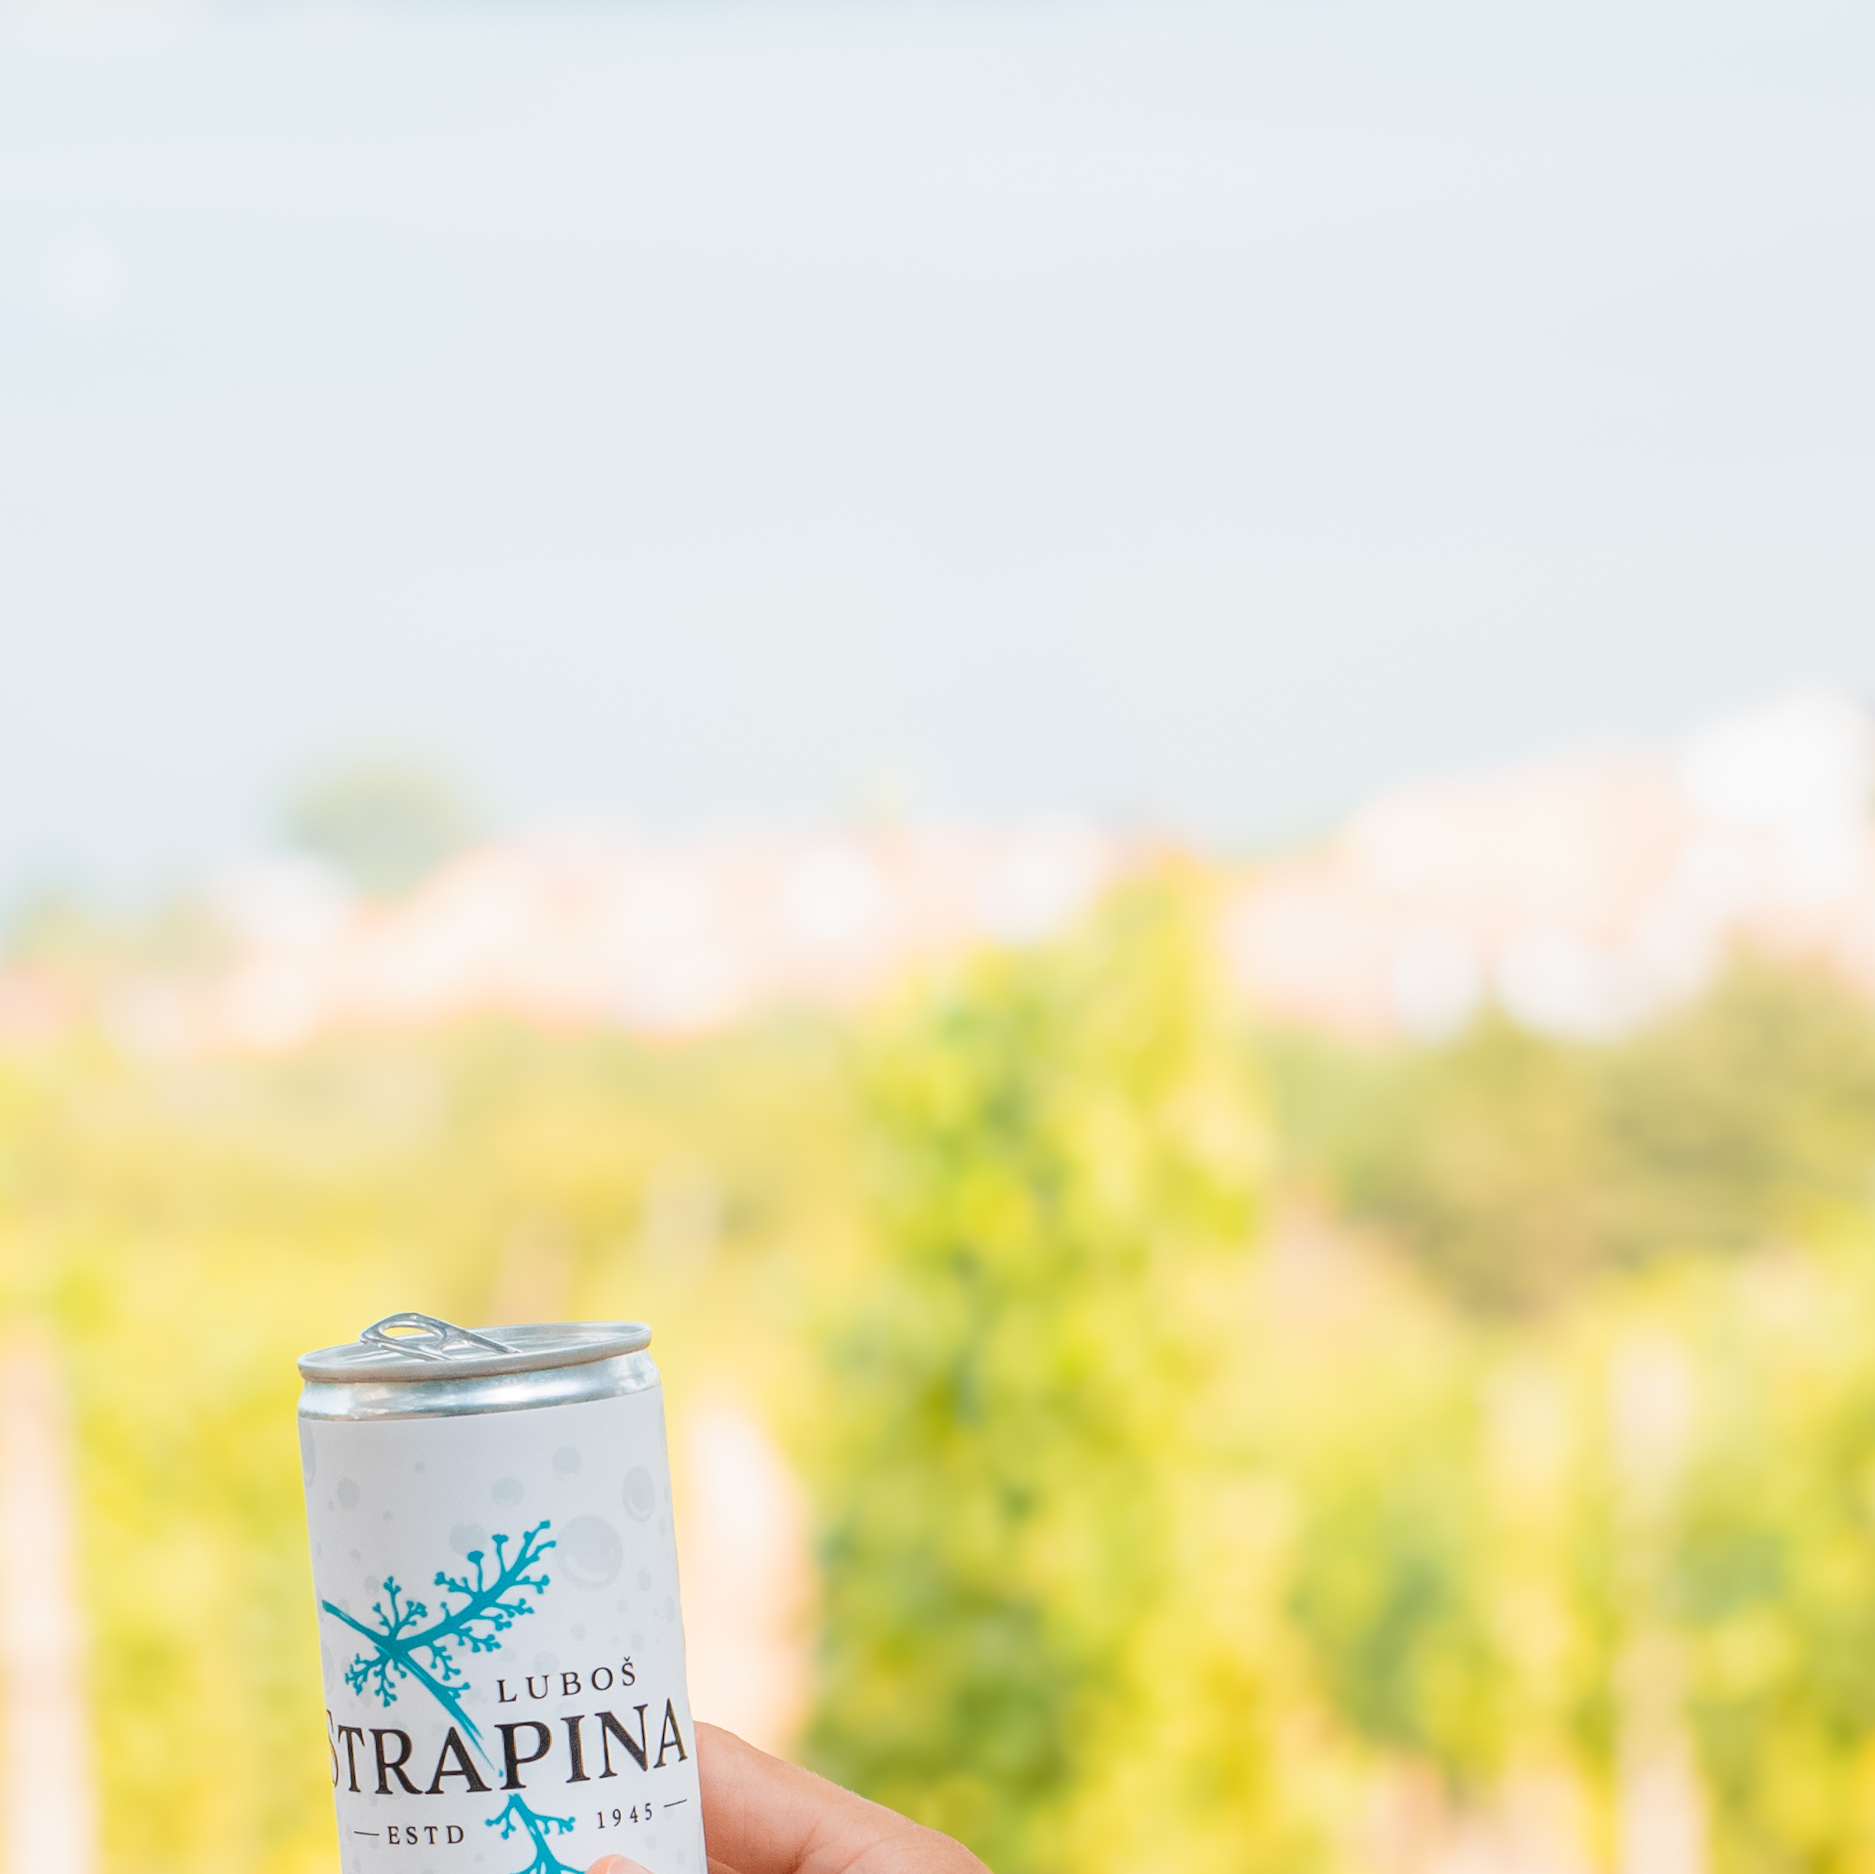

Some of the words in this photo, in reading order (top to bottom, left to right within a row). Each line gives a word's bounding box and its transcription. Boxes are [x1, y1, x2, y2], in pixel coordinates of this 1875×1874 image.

[497, 1656, 637, 1704] LUBOŠ
[387, 1824, 466, 1846] ESTD
[596, 1802, 654, 1830] 1945
